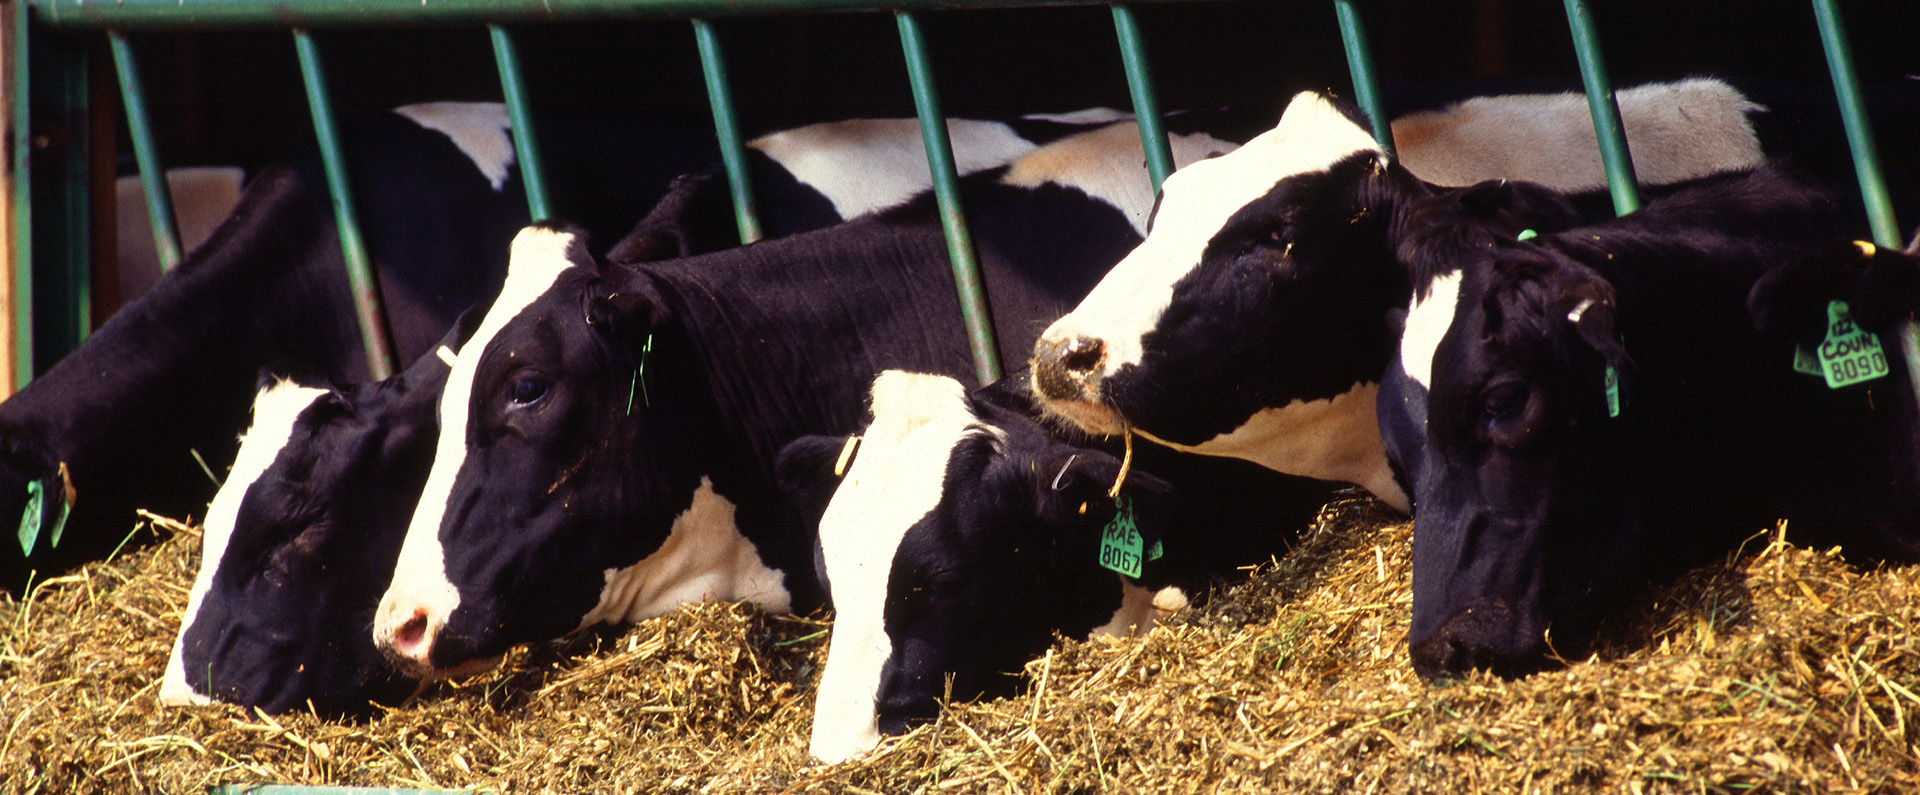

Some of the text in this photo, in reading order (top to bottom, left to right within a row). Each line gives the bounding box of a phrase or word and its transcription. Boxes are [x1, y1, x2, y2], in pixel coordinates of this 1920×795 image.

[1831, 352, 1886, 382] 8090
[1106, 521, 1136, 546] RAE
[1103, 544, 1140, 574] 8067
